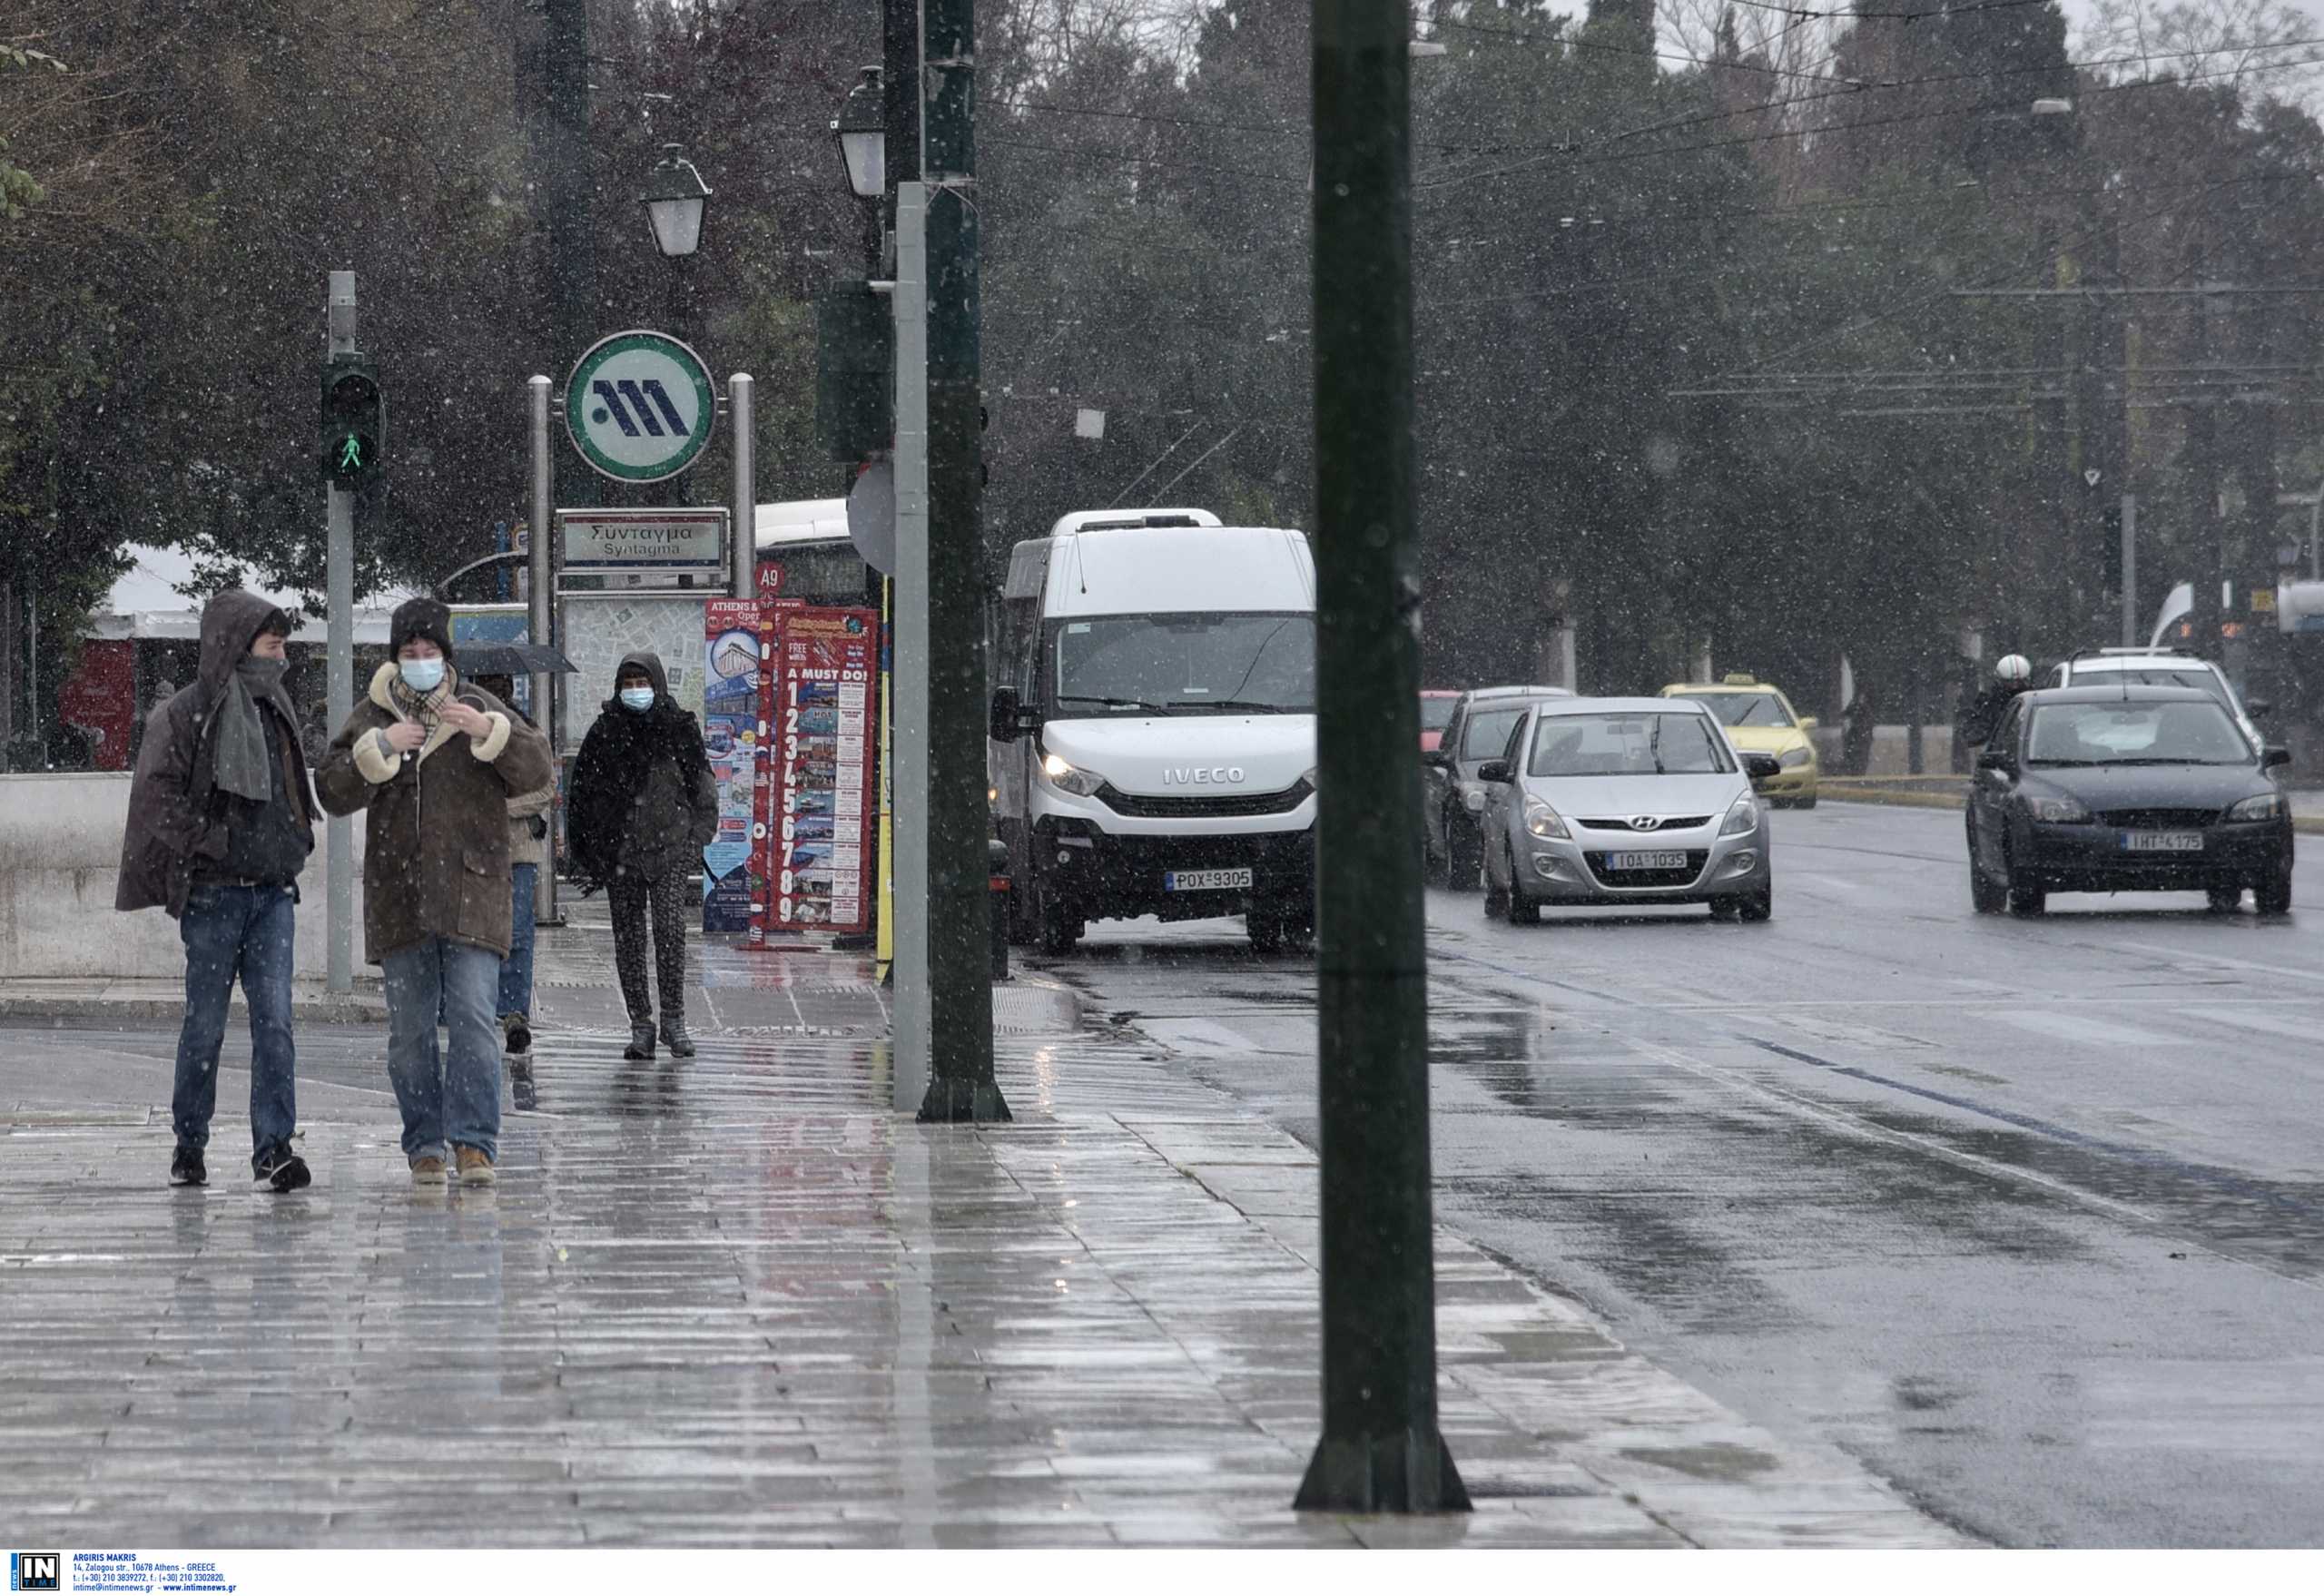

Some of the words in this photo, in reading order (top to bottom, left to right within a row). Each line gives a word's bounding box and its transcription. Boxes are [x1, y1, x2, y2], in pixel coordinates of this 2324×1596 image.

[591, 525, 693, 543] Σύνταγμα
[604, 543, 680, 557] Syntagma
[761, 568, 778, 586] A9
[711, 602, 750, 611] ATHENS
[788, 643, 807, 654] FREE
[787, 668, 798, 679] A
[802, 668, 839, 680] MUST
[842, 669, 868, 682] DO!
[787, 682, 797, 706] 1
[786, 708, 798, 734] 2
[784, 735, 797, 760] 3
[783, 761, 796, 787] 4
[1162, 766, 1246, 784] IVECO
[783, 788, 796, 813] 5
[782, 815, 794, 840] 6
[782, 842, 794, 867] 7
[780, 869, 793, 894] 8
[780, 897, 792, 922] 9
